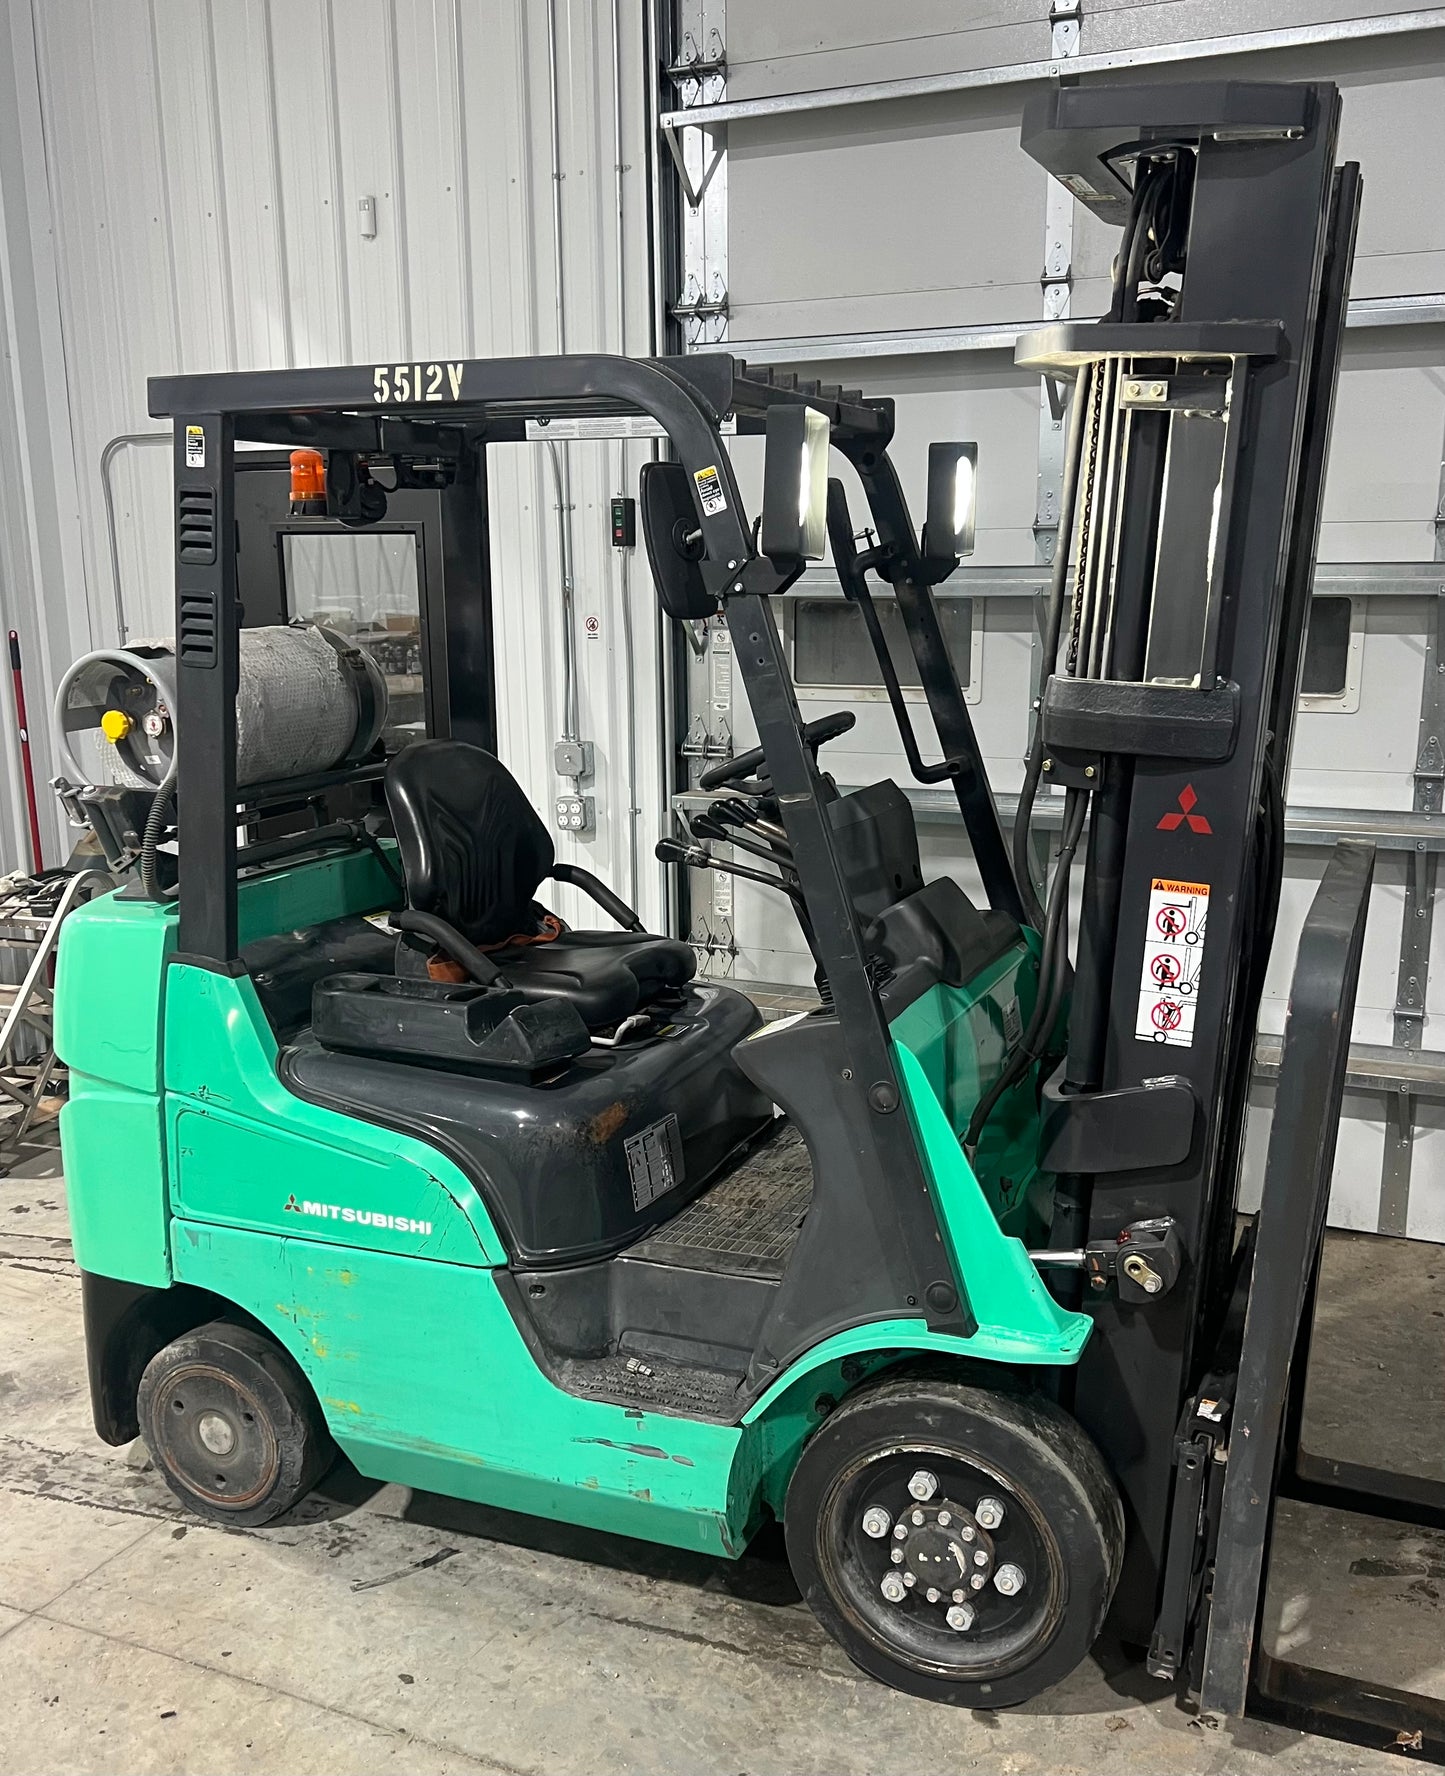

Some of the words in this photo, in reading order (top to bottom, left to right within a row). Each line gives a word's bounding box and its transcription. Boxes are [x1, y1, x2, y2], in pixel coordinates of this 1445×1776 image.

[373, 363, 463, 403] 5512V
[1167, 884, 1208, 895] WARNING
[302, 1200, 432, 1235] MITSUBISHI
